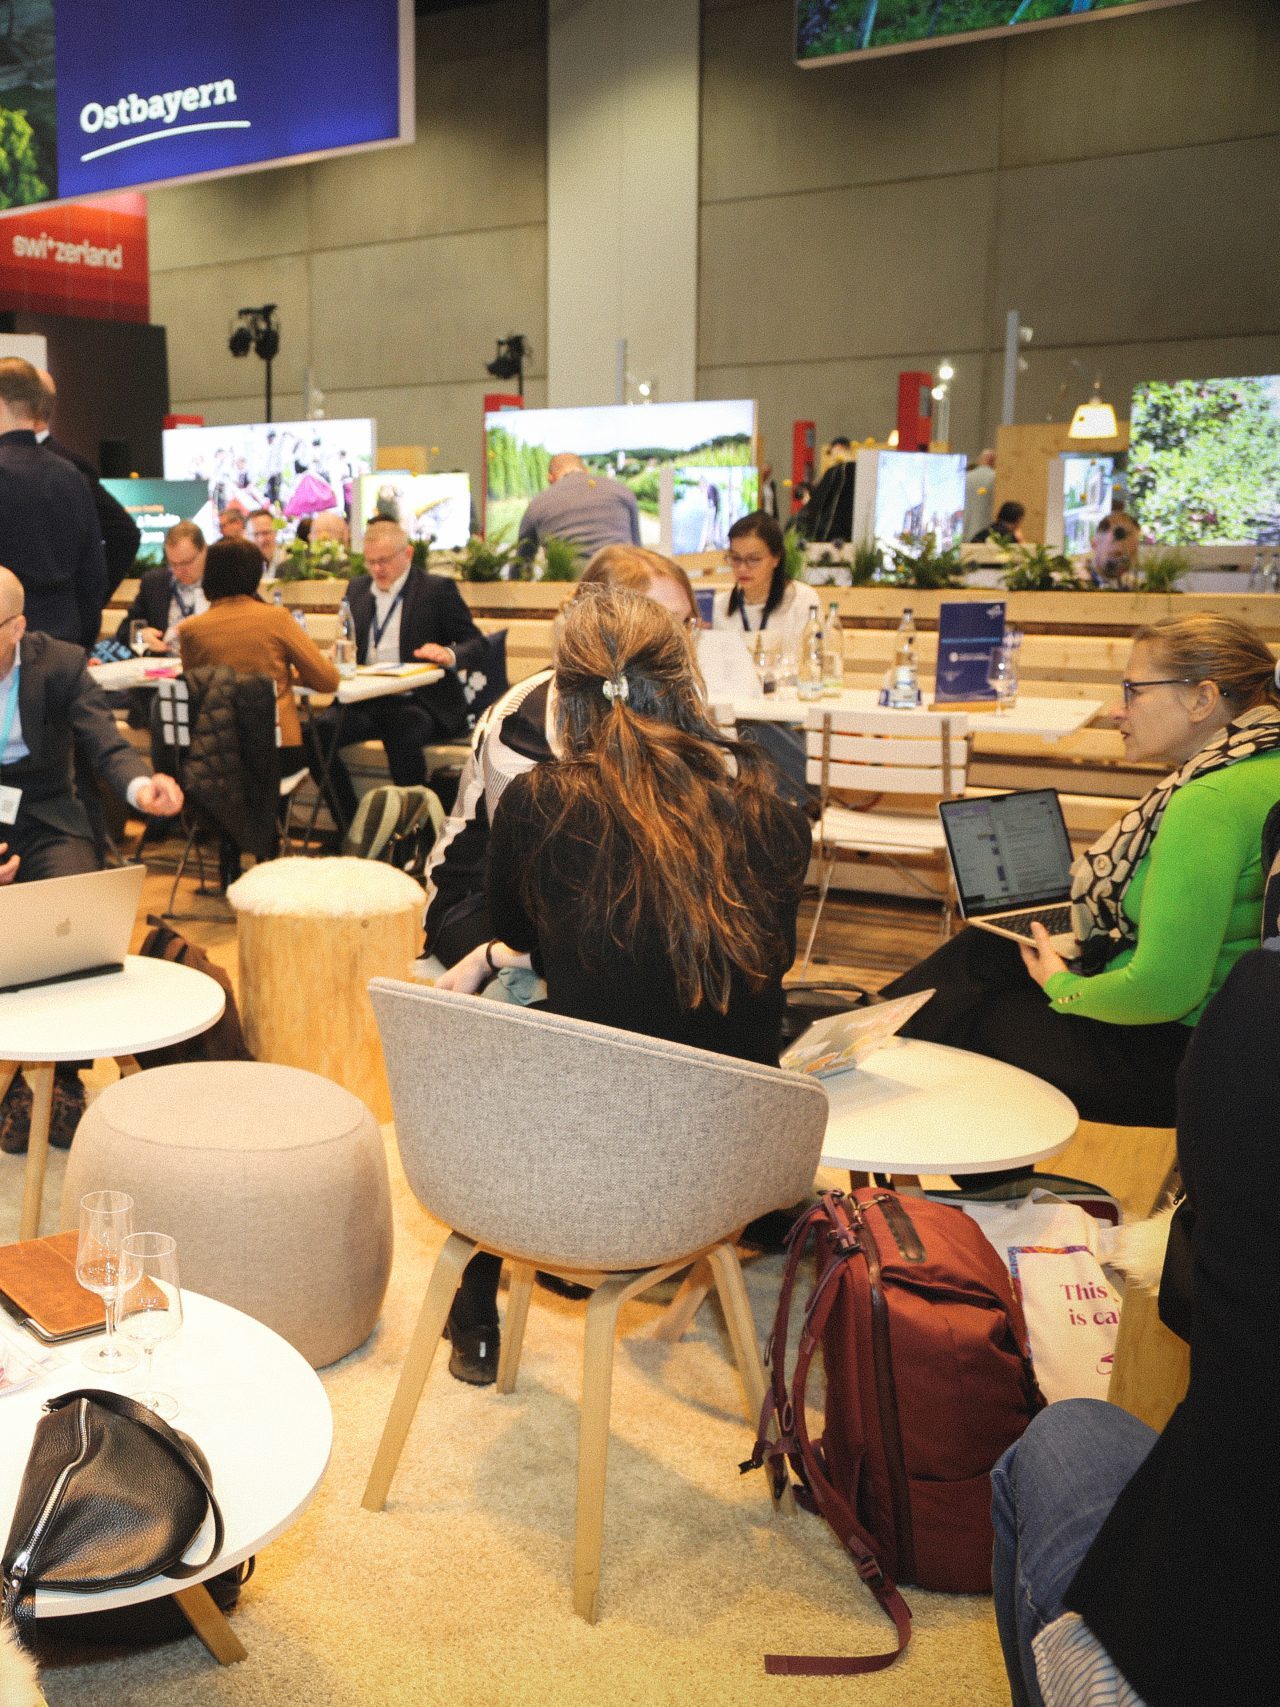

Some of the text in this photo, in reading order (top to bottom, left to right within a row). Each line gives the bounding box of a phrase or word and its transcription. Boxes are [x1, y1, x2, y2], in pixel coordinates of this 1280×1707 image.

[80, 78, 238, 133] Ostbayern
[1060, 1281, 1109, 1301] This
[1069, 1308, 1121, 1326] is ca
